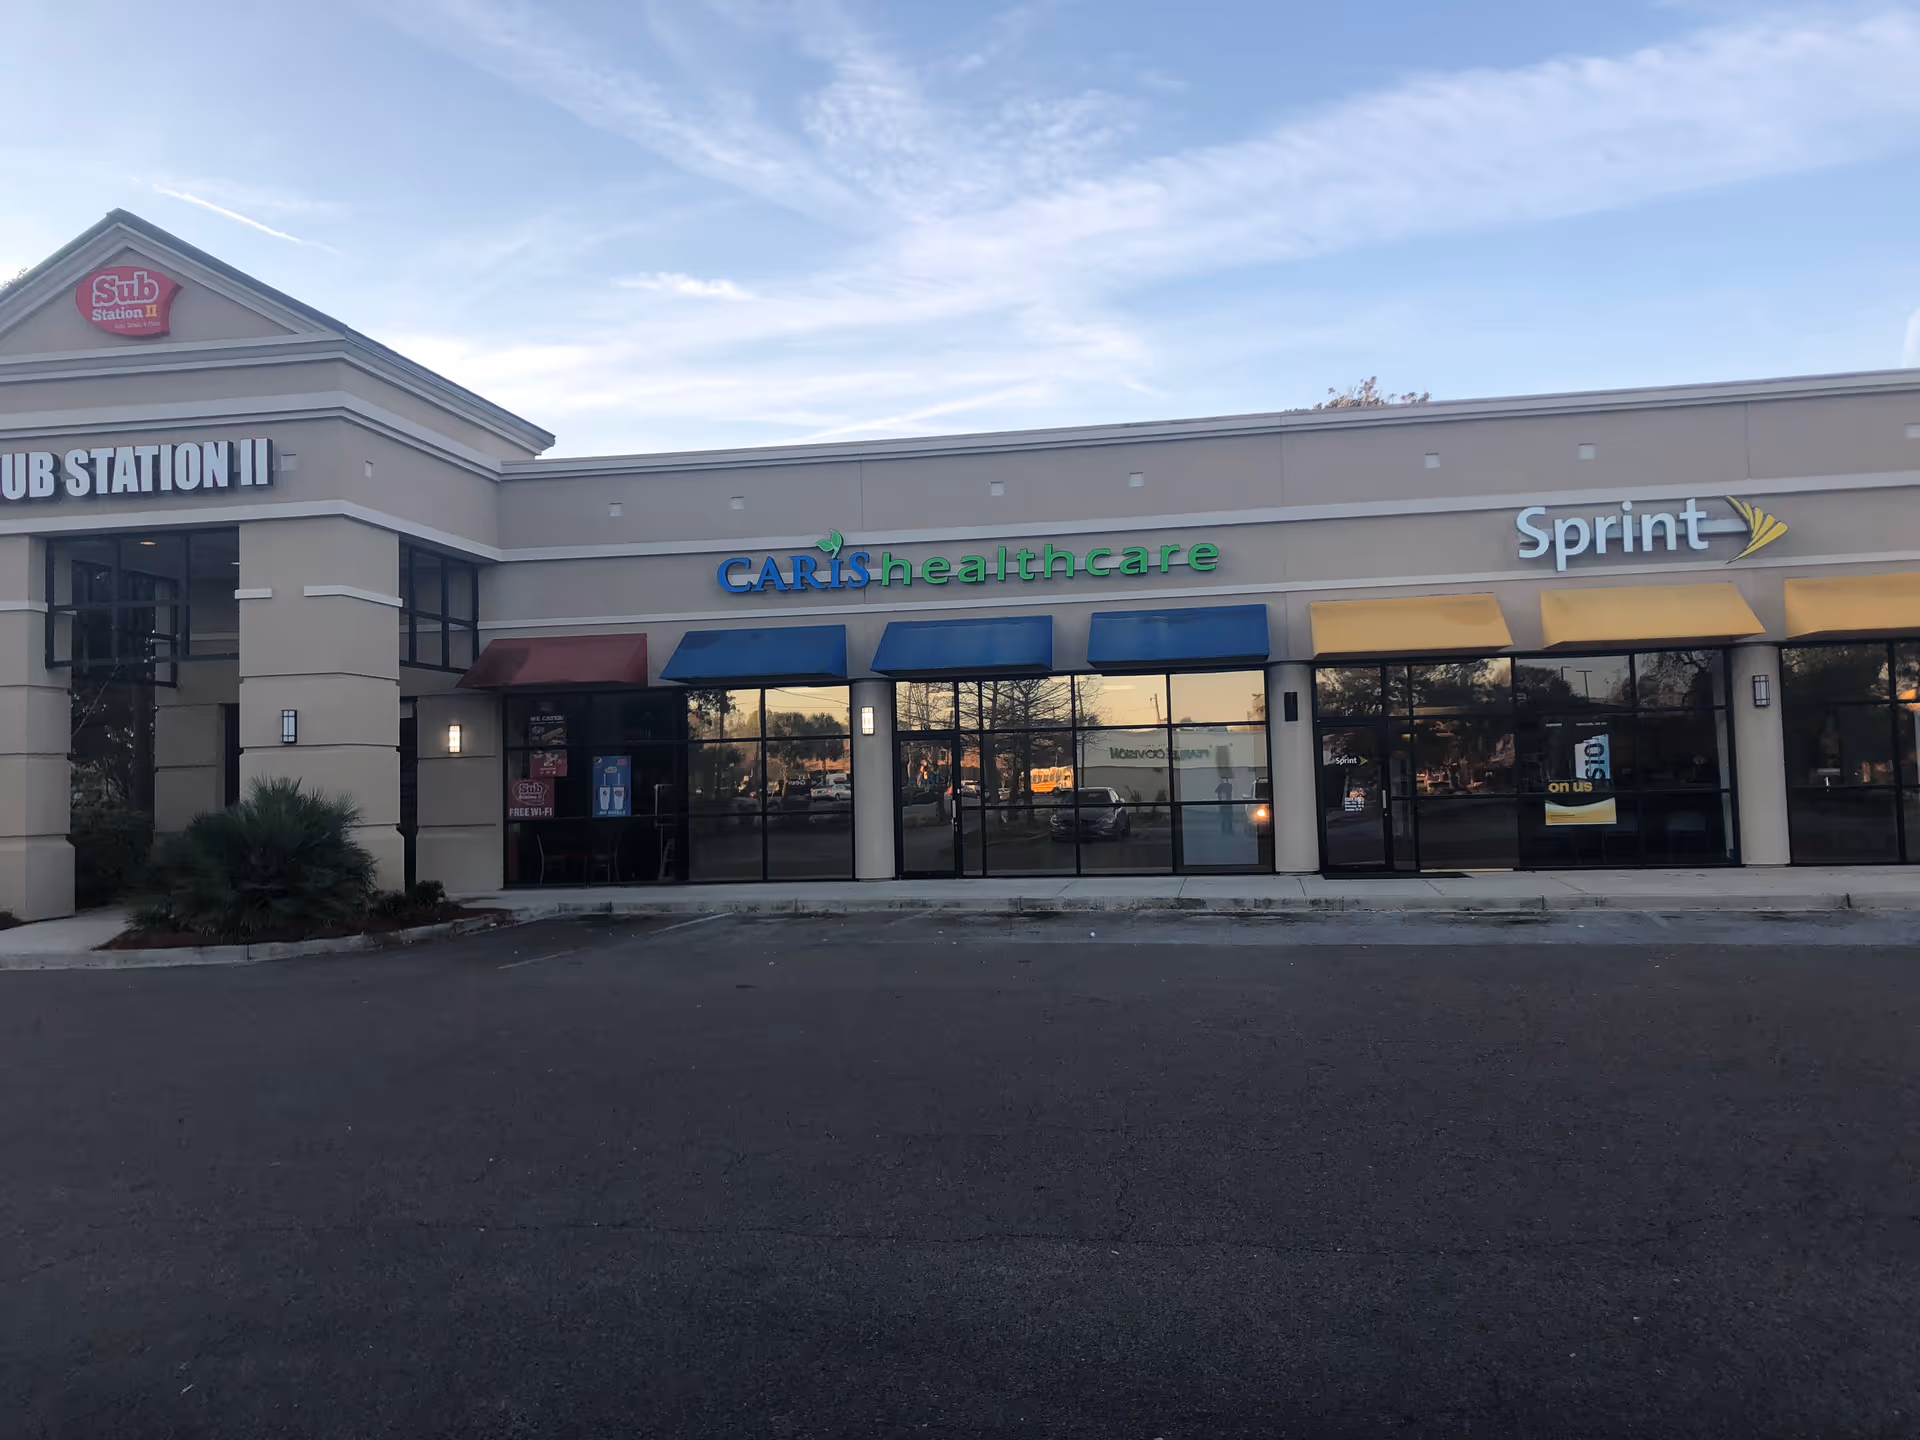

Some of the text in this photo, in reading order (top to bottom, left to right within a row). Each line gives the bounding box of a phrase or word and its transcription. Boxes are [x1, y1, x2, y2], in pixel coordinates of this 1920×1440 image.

[93, 271, 159, 307] Sub
[92, 304, 157, 320] Station II
[1, 437, 271, 500] UB STATION II
[1516, 498, 1709, 572] Sprint
[717, 542, 1219, 594] CARIS healthcare
[1335, 756, 1358, 766] Sprint
[1584, 743, 1606, 780] S10
[519, 782, 543, 795] Sub
[1548, 781, 1593, 793] on us
[509, 807, 552, 817] FREE WI-FI
